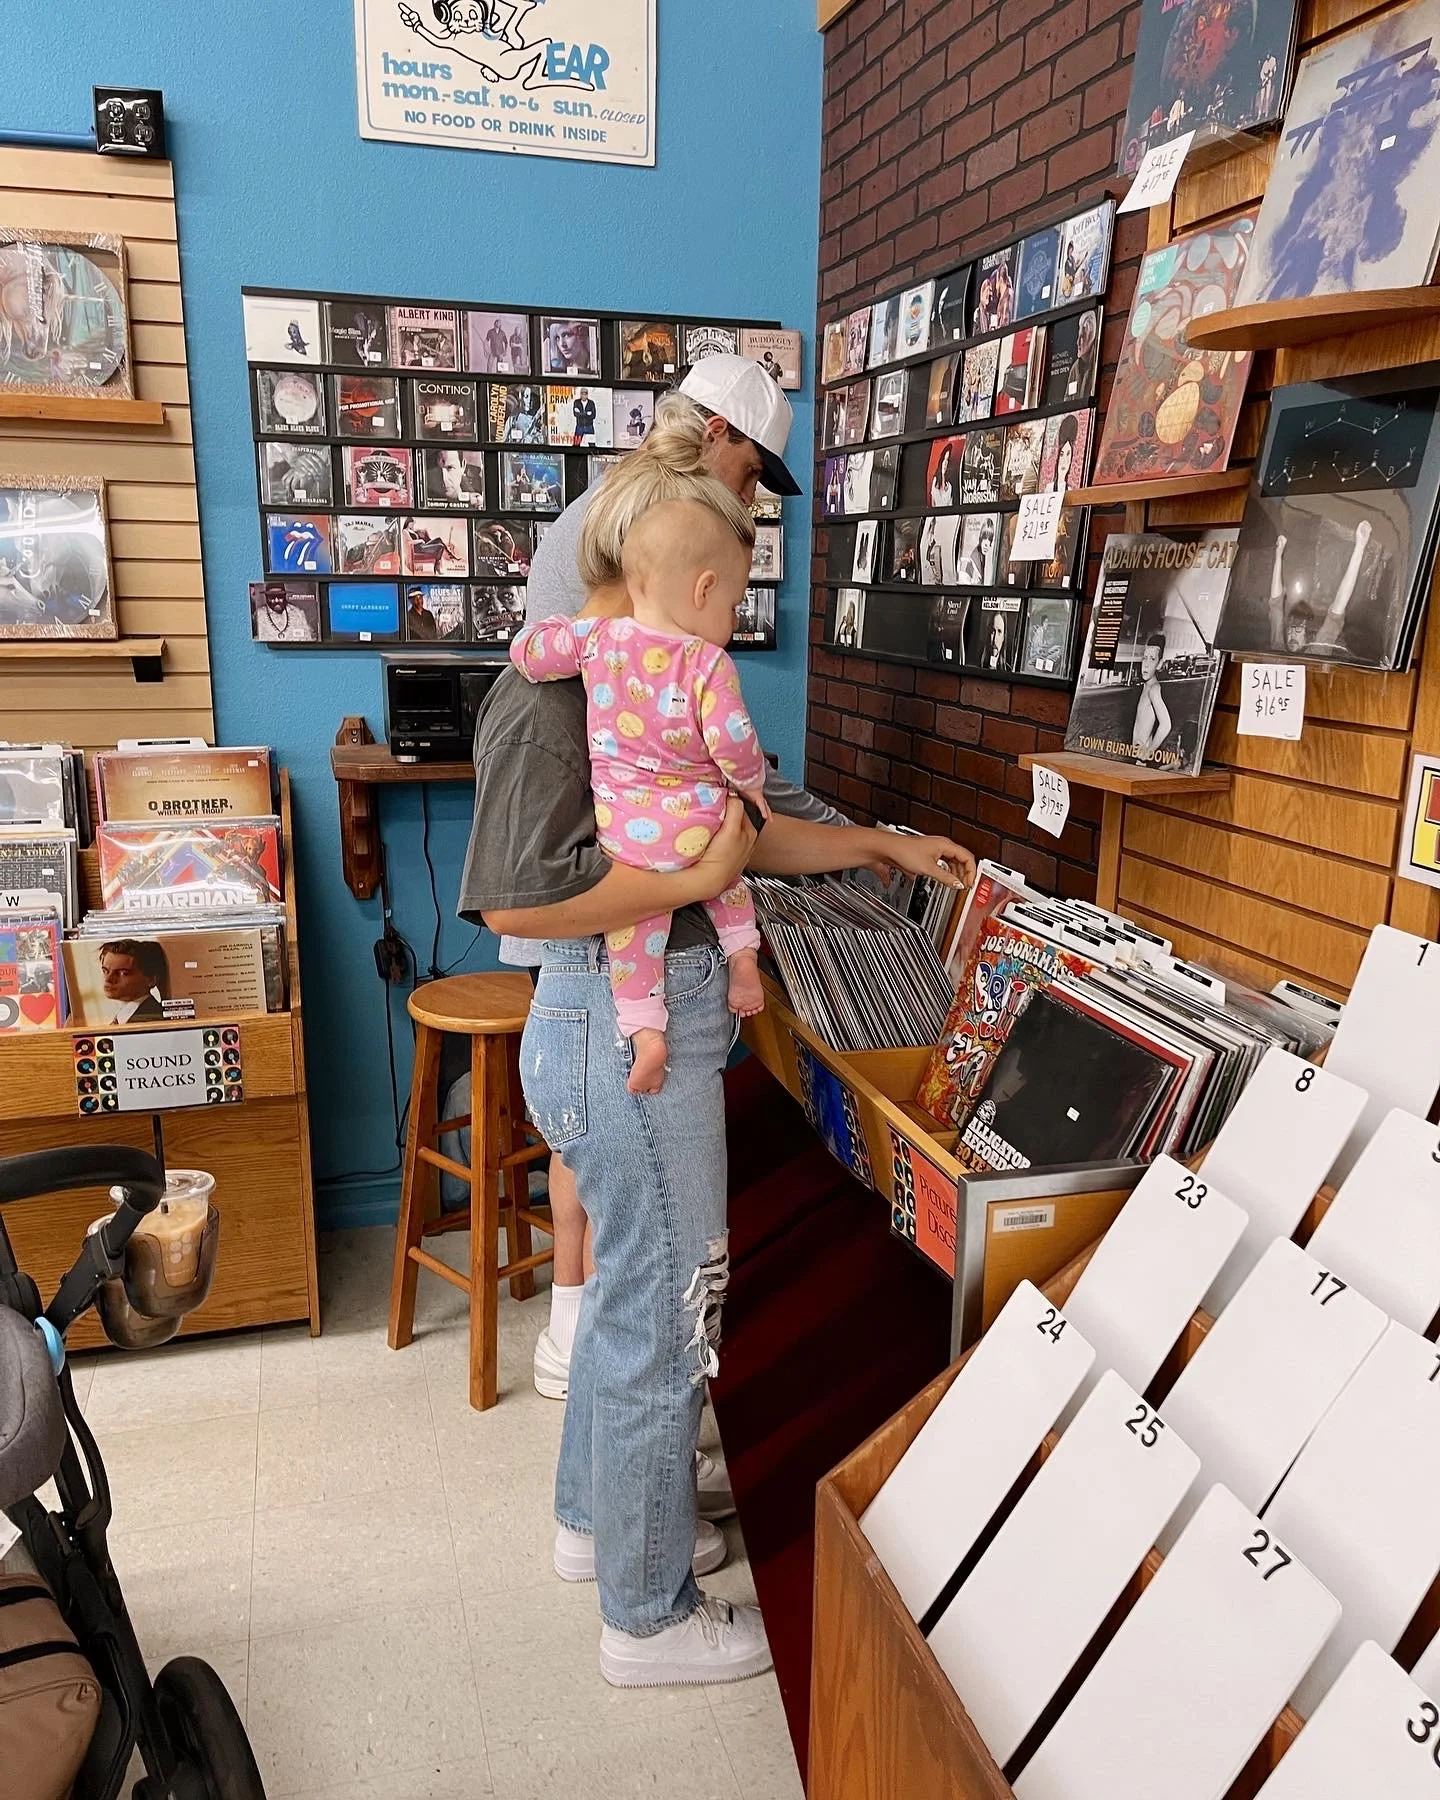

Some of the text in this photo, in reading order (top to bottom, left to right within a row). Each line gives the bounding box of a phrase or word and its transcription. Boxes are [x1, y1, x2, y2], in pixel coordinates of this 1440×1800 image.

[382, 52, 453, 81] hours
[545, 42, 610, 90] EAR
[499, 94, 540, 112] 10-6
[600, 108, 646, 125] CLOSED
[404, 110, 607, 143] NO FOOD OR DRINK INSIDE
[1147, 149, 1178, 173] SALE
[398, 308, 454, 321] ALBERT KING
[749, 336, 793, 346] BUDDY GUY
[418, 383, 471, 395] CONTINO
[550, 395, 569, 404] CRAY
[349, 400, 384, 410] PROMOTIONAL
[490, 383, 500, 423] CAROLYN
[550, 426, 558, 434] HI
[550, 435, 582, 445] RHYTHM
[963, 479, 977, 491] VAN
[427, 501, 448, 509] tommy
[962, 489, 998, 504] MORRISON
[1024, 496, 1056, 518] SALE
[355, 520, 375, 528] MAHAL
[1103, 541, 1239, 569] ADAM'S HOUSE CAT
[1251, 669, 1296, 691] SALE
[1078, 735, 1105, 751] TOWN
[1038, 770, 1063, 793] SALE
[148, 798, 233, 811] O BROTHER,
[6, 896, 20, 907] W
[122, 890, 258, 909] GUARDIANS
[981, 935, 1005, 953] JOE
[1417, 942, 1430, 966] 1
[979, 1010, 1015, 1043] BLU
[125, 1053, 192, 1071] SOUND
[124, 1072, 197, 1091] TRACKS
[1295, 1067, 1316, 1092] 8
[967, 1115, 1032, 1169] ALLIGATOR
[956, 1141, 993, 1173] 50 YE
[918, 1173, 957, 1226] Picture
[1174, 1175, 1208, 1209] 23
[926, 1210, 956, 1253] Discs
[1310, 1271, 1348, 1306] 17
[1036, 1308, 1068, 1344] 24
[1124, 1403, 1166, 1448] 25
[1242, 1528, 1292, 1581] 27
